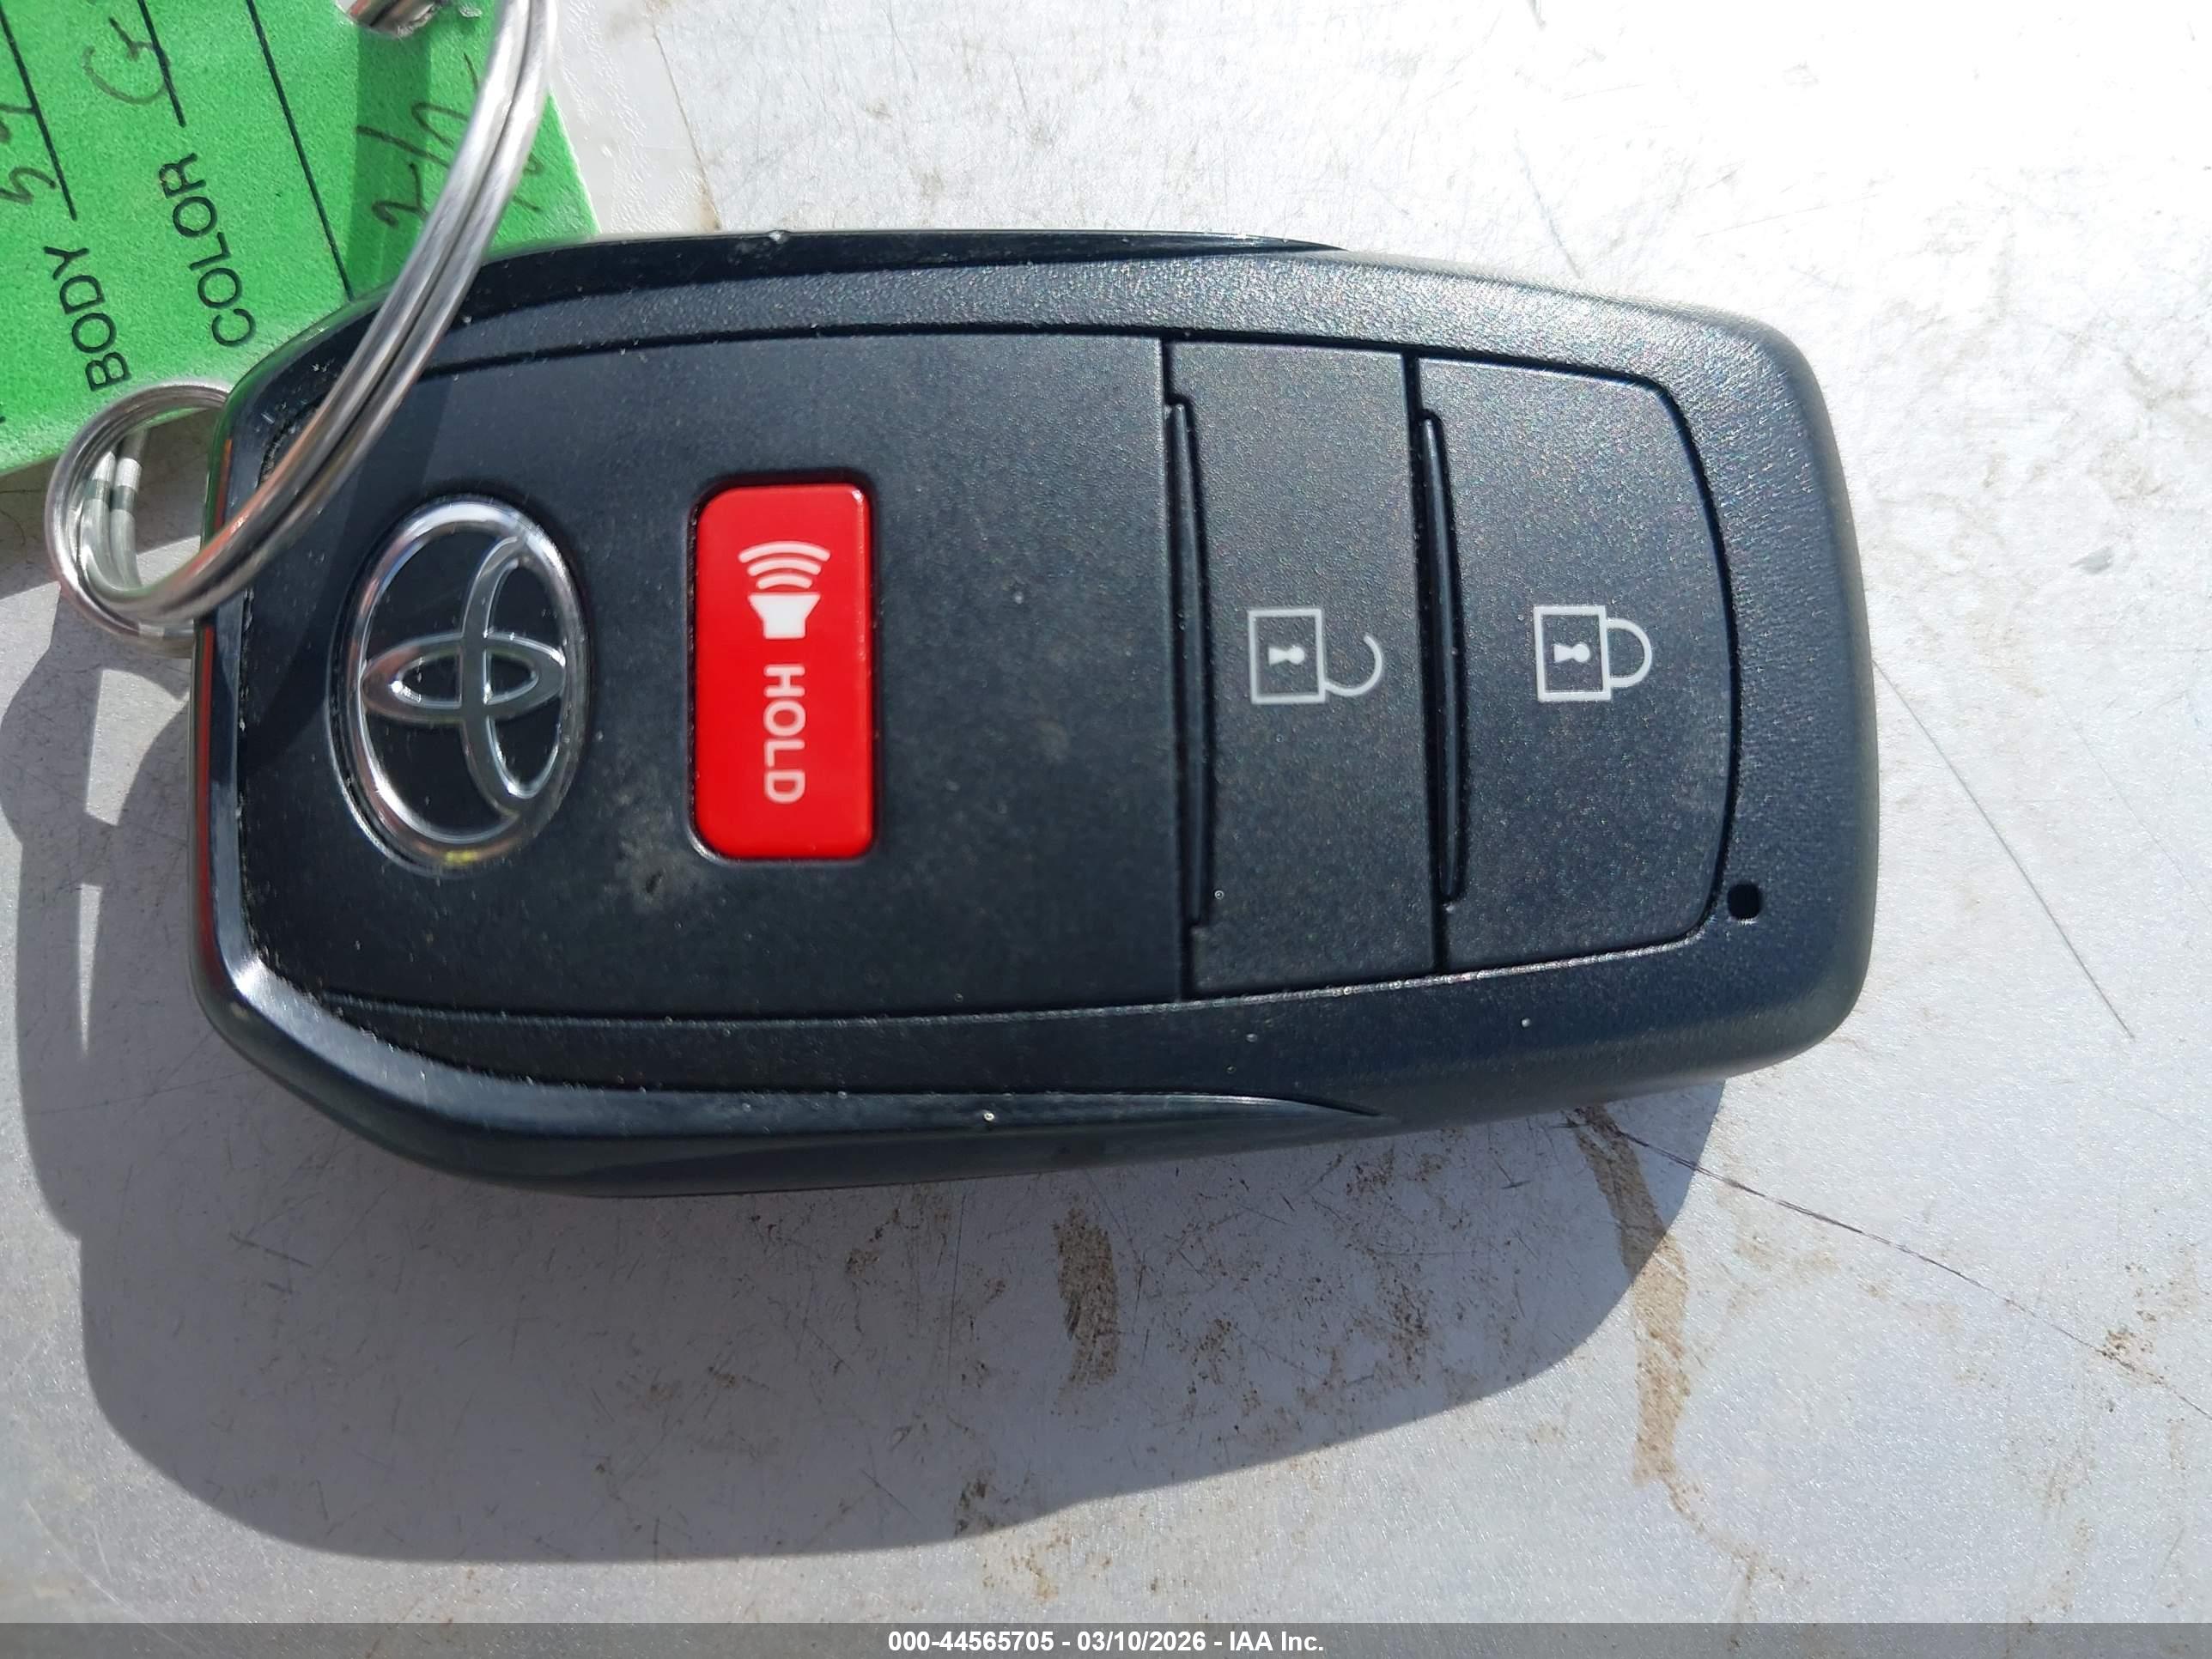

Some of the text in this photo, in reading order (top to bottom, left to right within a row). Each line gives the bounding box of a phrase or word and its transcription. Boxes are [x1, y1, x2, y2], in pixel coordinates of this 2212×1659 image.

[43, 246, 131, 392] BODY
[158, 151, 257, 348] COLOR
[763, 663, 806, 805] HOLD
